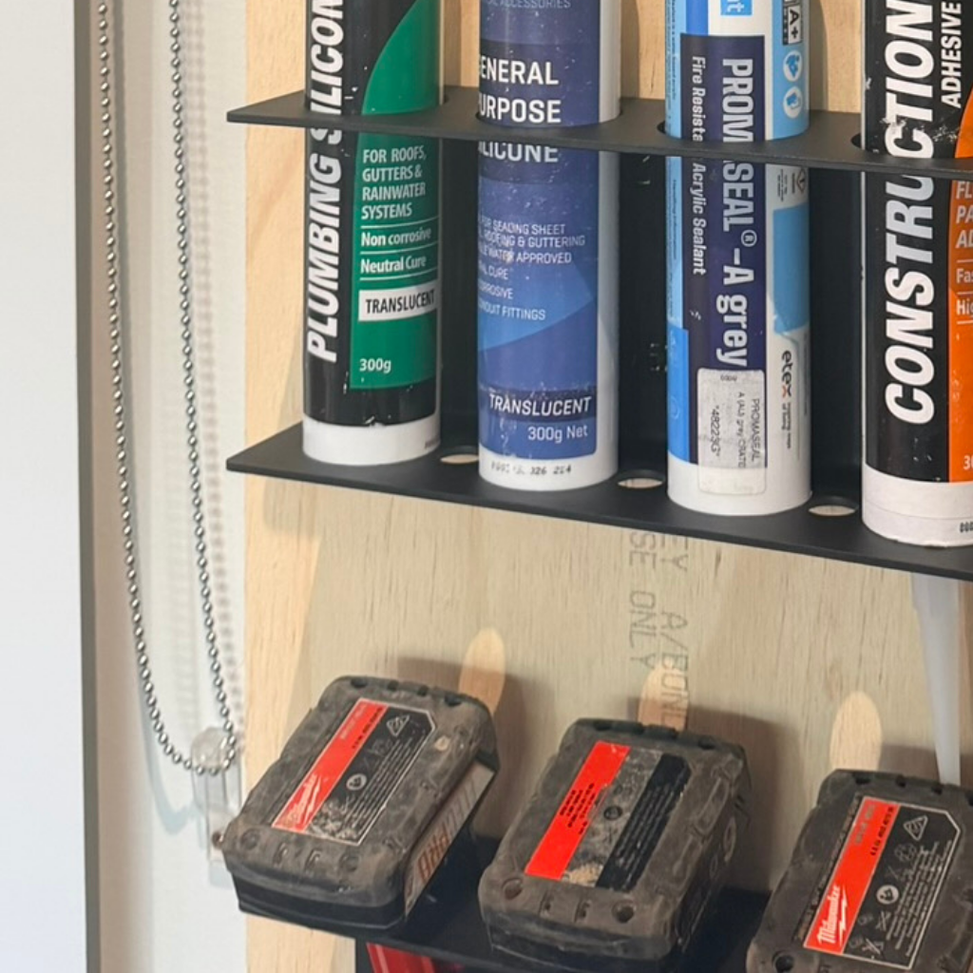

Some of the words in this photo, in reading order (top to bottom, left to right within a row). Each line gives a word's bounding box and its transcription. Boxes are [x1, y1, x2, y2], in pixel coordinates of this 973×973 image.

[941, 1, 962, 109] ADHESIVE
[692, 56, 706, 84] Fire
[362, 148, 388, 164] FOR
[390, 144, 427, 162] ROOFS,
[362, 165, 414, 182] GUTTERS
[414, 163, 423, 178] &
[362, 181, 426, 201] RAINWATER
[690, 162, 707, 214] Acrylic
[361, 202, 413, 220] SYSTEMS
[361, 231, 386, 246] Non
[387, 227, 432, 245] corrosive
[531, 223, 566, 235] SHEET
[517, 236, 526, 248] &
[528, 235, 586, 248] GUTTERING
[691, 216, 706, 276] Sealant
[307, 152, 342, 363] PLUMBING
[360, 256, 404, 274] Neutral
[405, 255, 427, 269] Cure
[516, 252, 572, 264] APPROVED
[365, 288, 435, 314] TRANSLUCENT
[501, 305, 547, 321] FITTINGS
[716, 293, 748, 368] grey
[359, 357, 392, 374] 300g
[780, 349, 794, 398] etex
[489, 393, 593, 417] TRANSLUCENT
[527, 426, 563, 444] 300g
[566, 425, 589, 439] Net
[750, 397, 761, 463] PROMASEAL
[629, 589, 657, 671] ONLY
